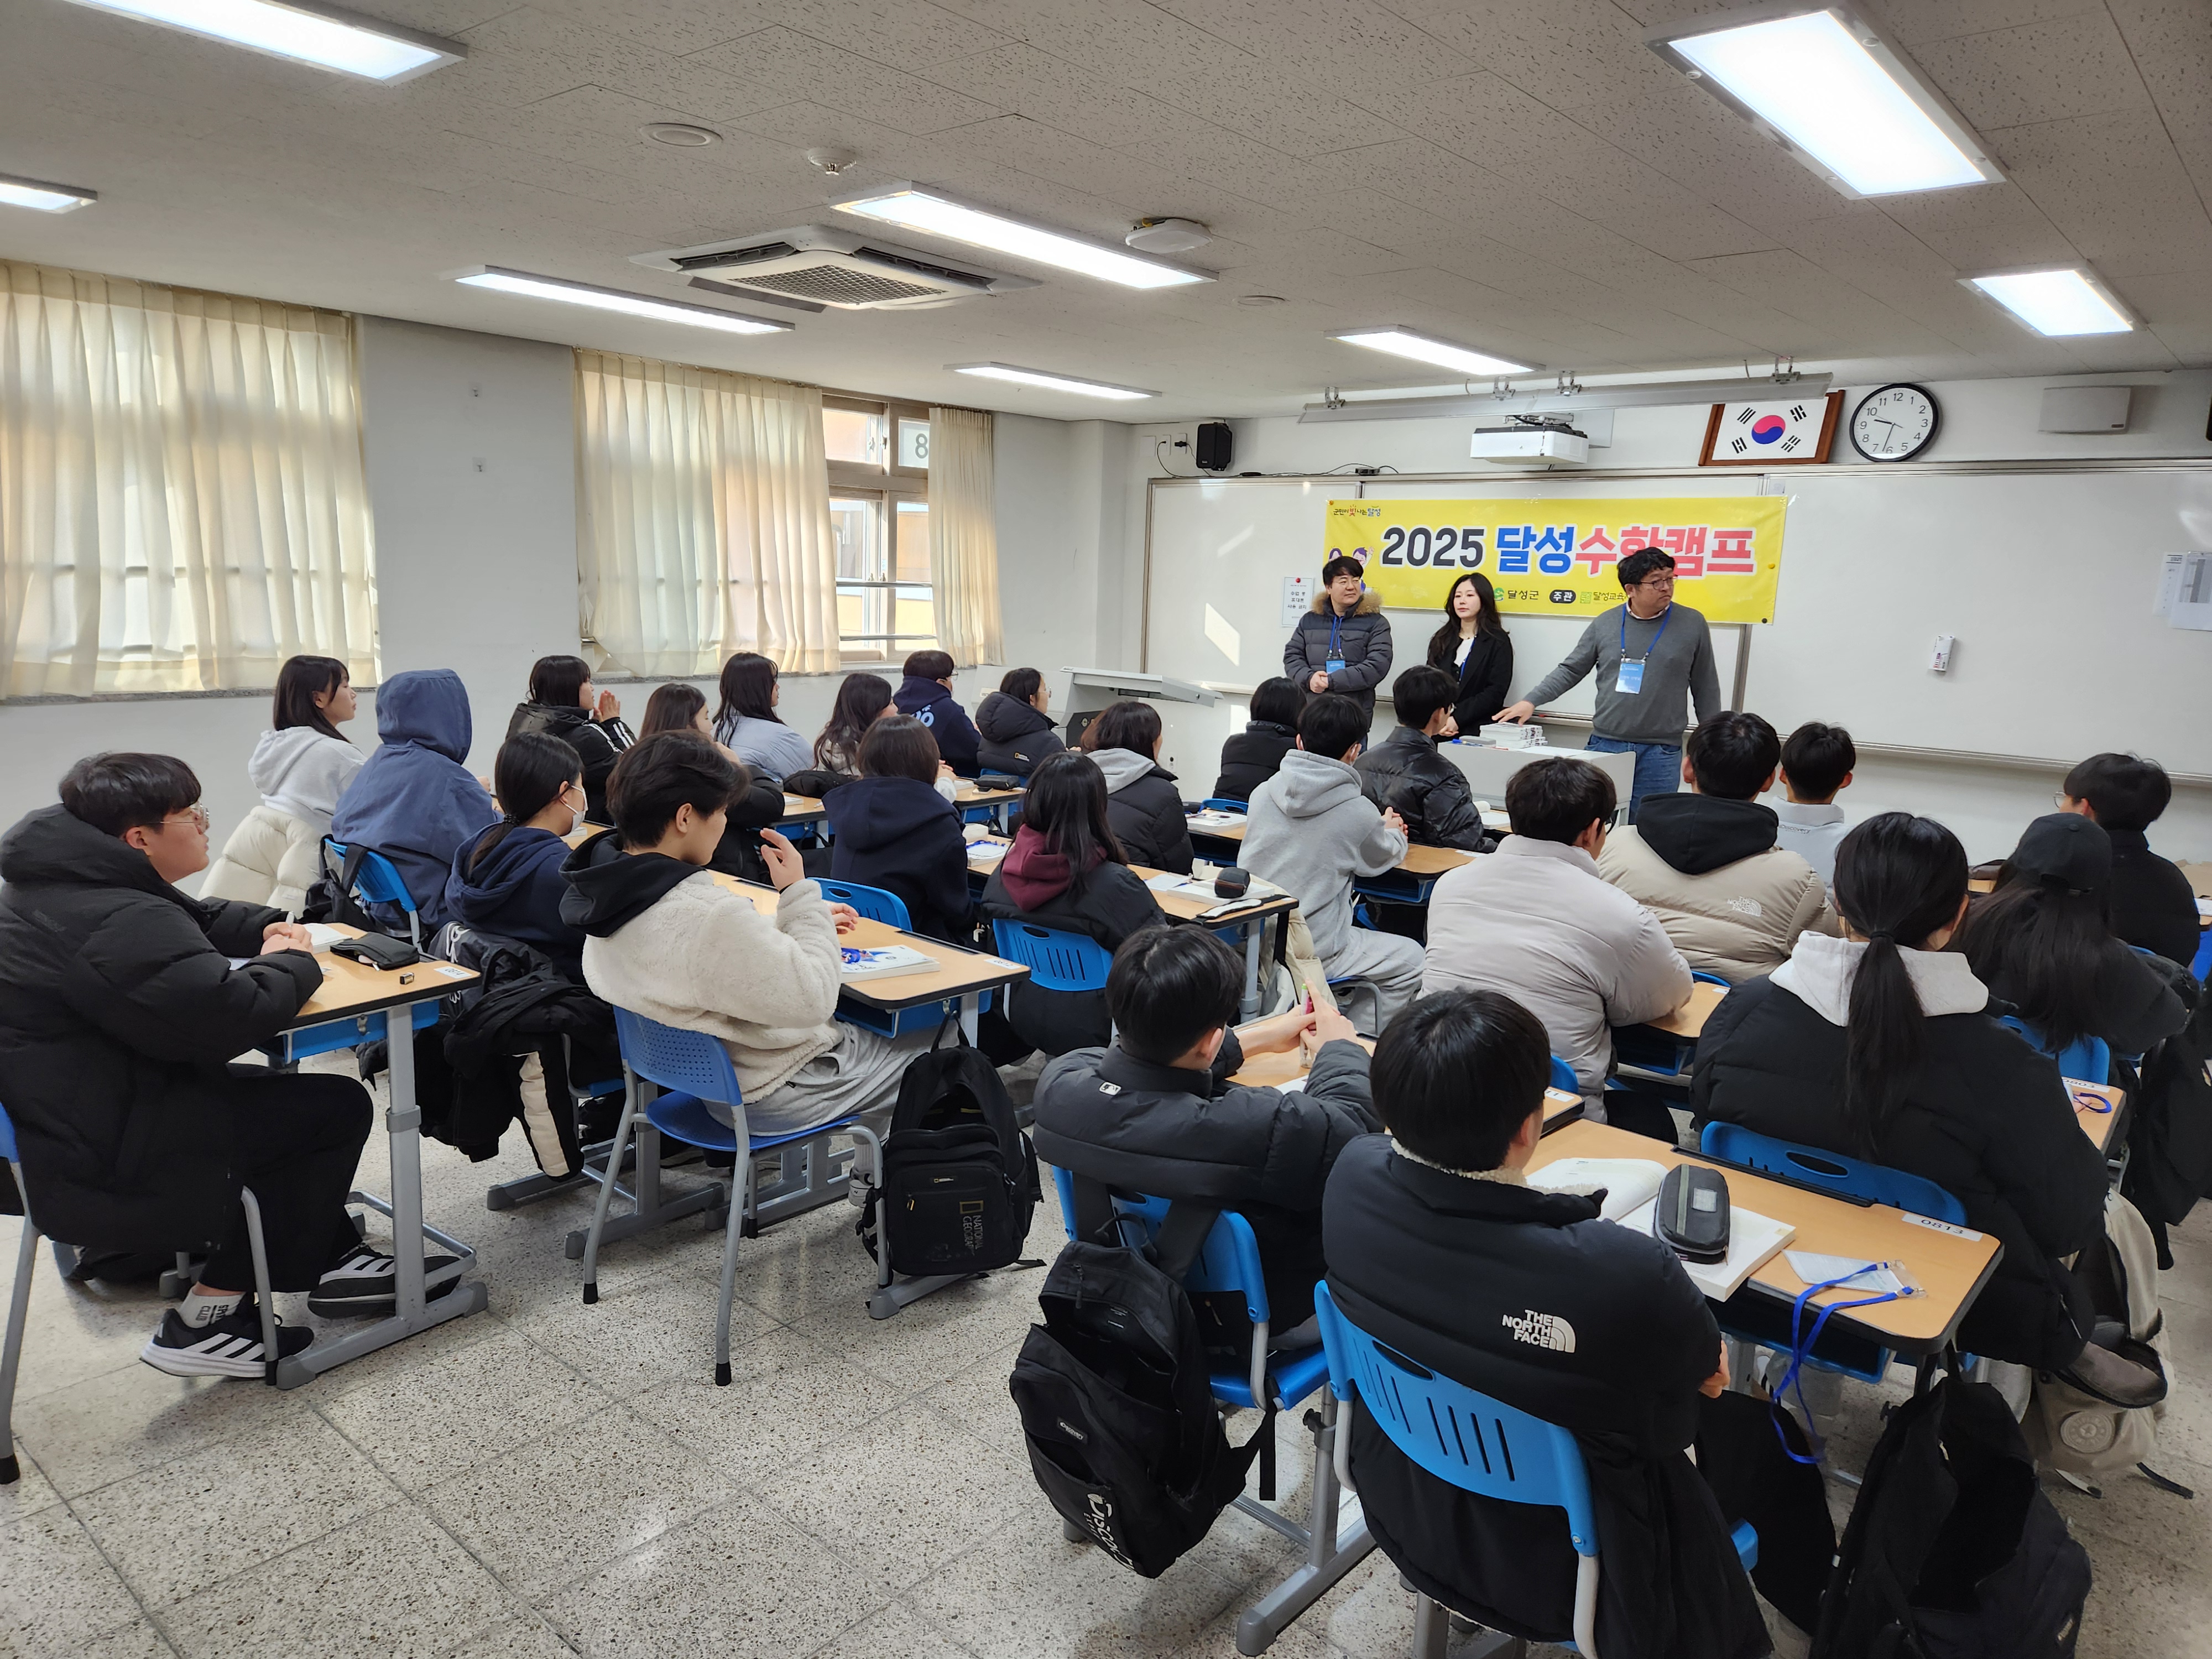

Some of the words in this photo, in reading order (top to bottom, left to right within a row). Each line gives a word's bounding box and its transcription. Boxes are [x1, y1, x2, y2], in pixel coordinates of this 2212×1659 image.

[1893, 392, 1903, 401] 12
[1910, 396, 1914, 405] 1
[1879, 397, 1887, 406] 11
[1866, 407, 1877, 416] 10
[1918, 405, 1926, 414] 2
[1860, 421, 1867, 430] 9
[1921, 419, 1928, 427] 3
[1862, 434, 1870, 442] 8
[1913, 432, 1921, 441] 4
[915, 433, 928, 459] 8
[1872, 444, 1879, 452] 7
[1901, 442, 1908, 451] 5
[1349, 507, 1367, 517] 빛나는
[1367, 507, 1381, 517] 달성
[1382, 526, 1485, 568] 2025
[1507, 589, 1540, 601] 달성군
[1553, 591, 1573, 602] 주관
[1727, 898, 1750, 907] NORTH
[1732, 905, 1750, 914] FACE
[1921, 1219, 1964, 1234] 0813
[962, 1215, 975, 1256] GEOGRAP
[972, 1214, 984, 1250] NATIONAL
[1524, 1308, 1553, 1327] THE
[1501, 1314, 1552, 1337] NORTH
[1513, 1328, 1550, 1349] FACE
